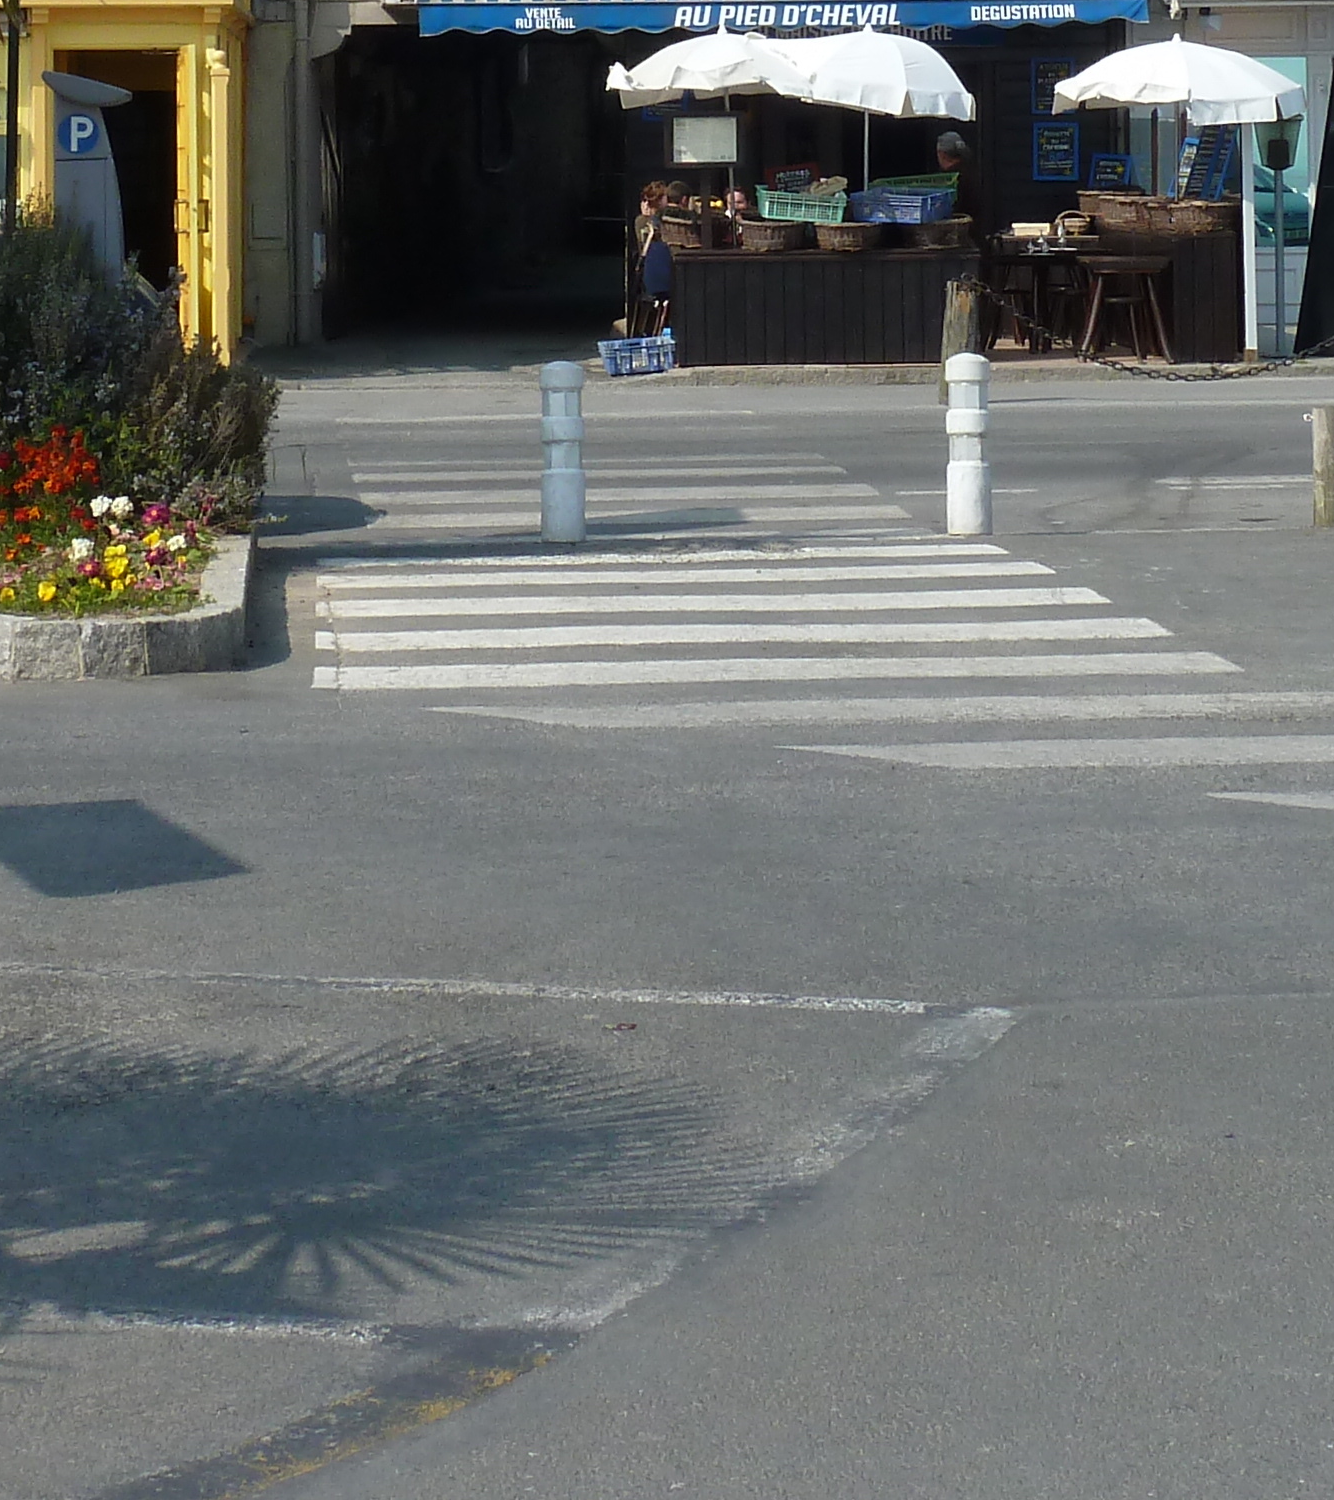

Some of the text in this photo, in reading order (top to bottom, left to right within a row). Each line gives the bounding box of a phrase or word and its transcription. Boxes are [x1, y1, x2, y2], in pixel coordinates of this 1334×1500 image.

[525, 7, 562, 19] VENTE
[674, 4, 901, 27] AU PIED D'CHEVAL
[970, 4, 1075, 21] DEGUSTATION
[515, 18, 576, 29] AU DETAIL
[70, 116, 94, 152] P
